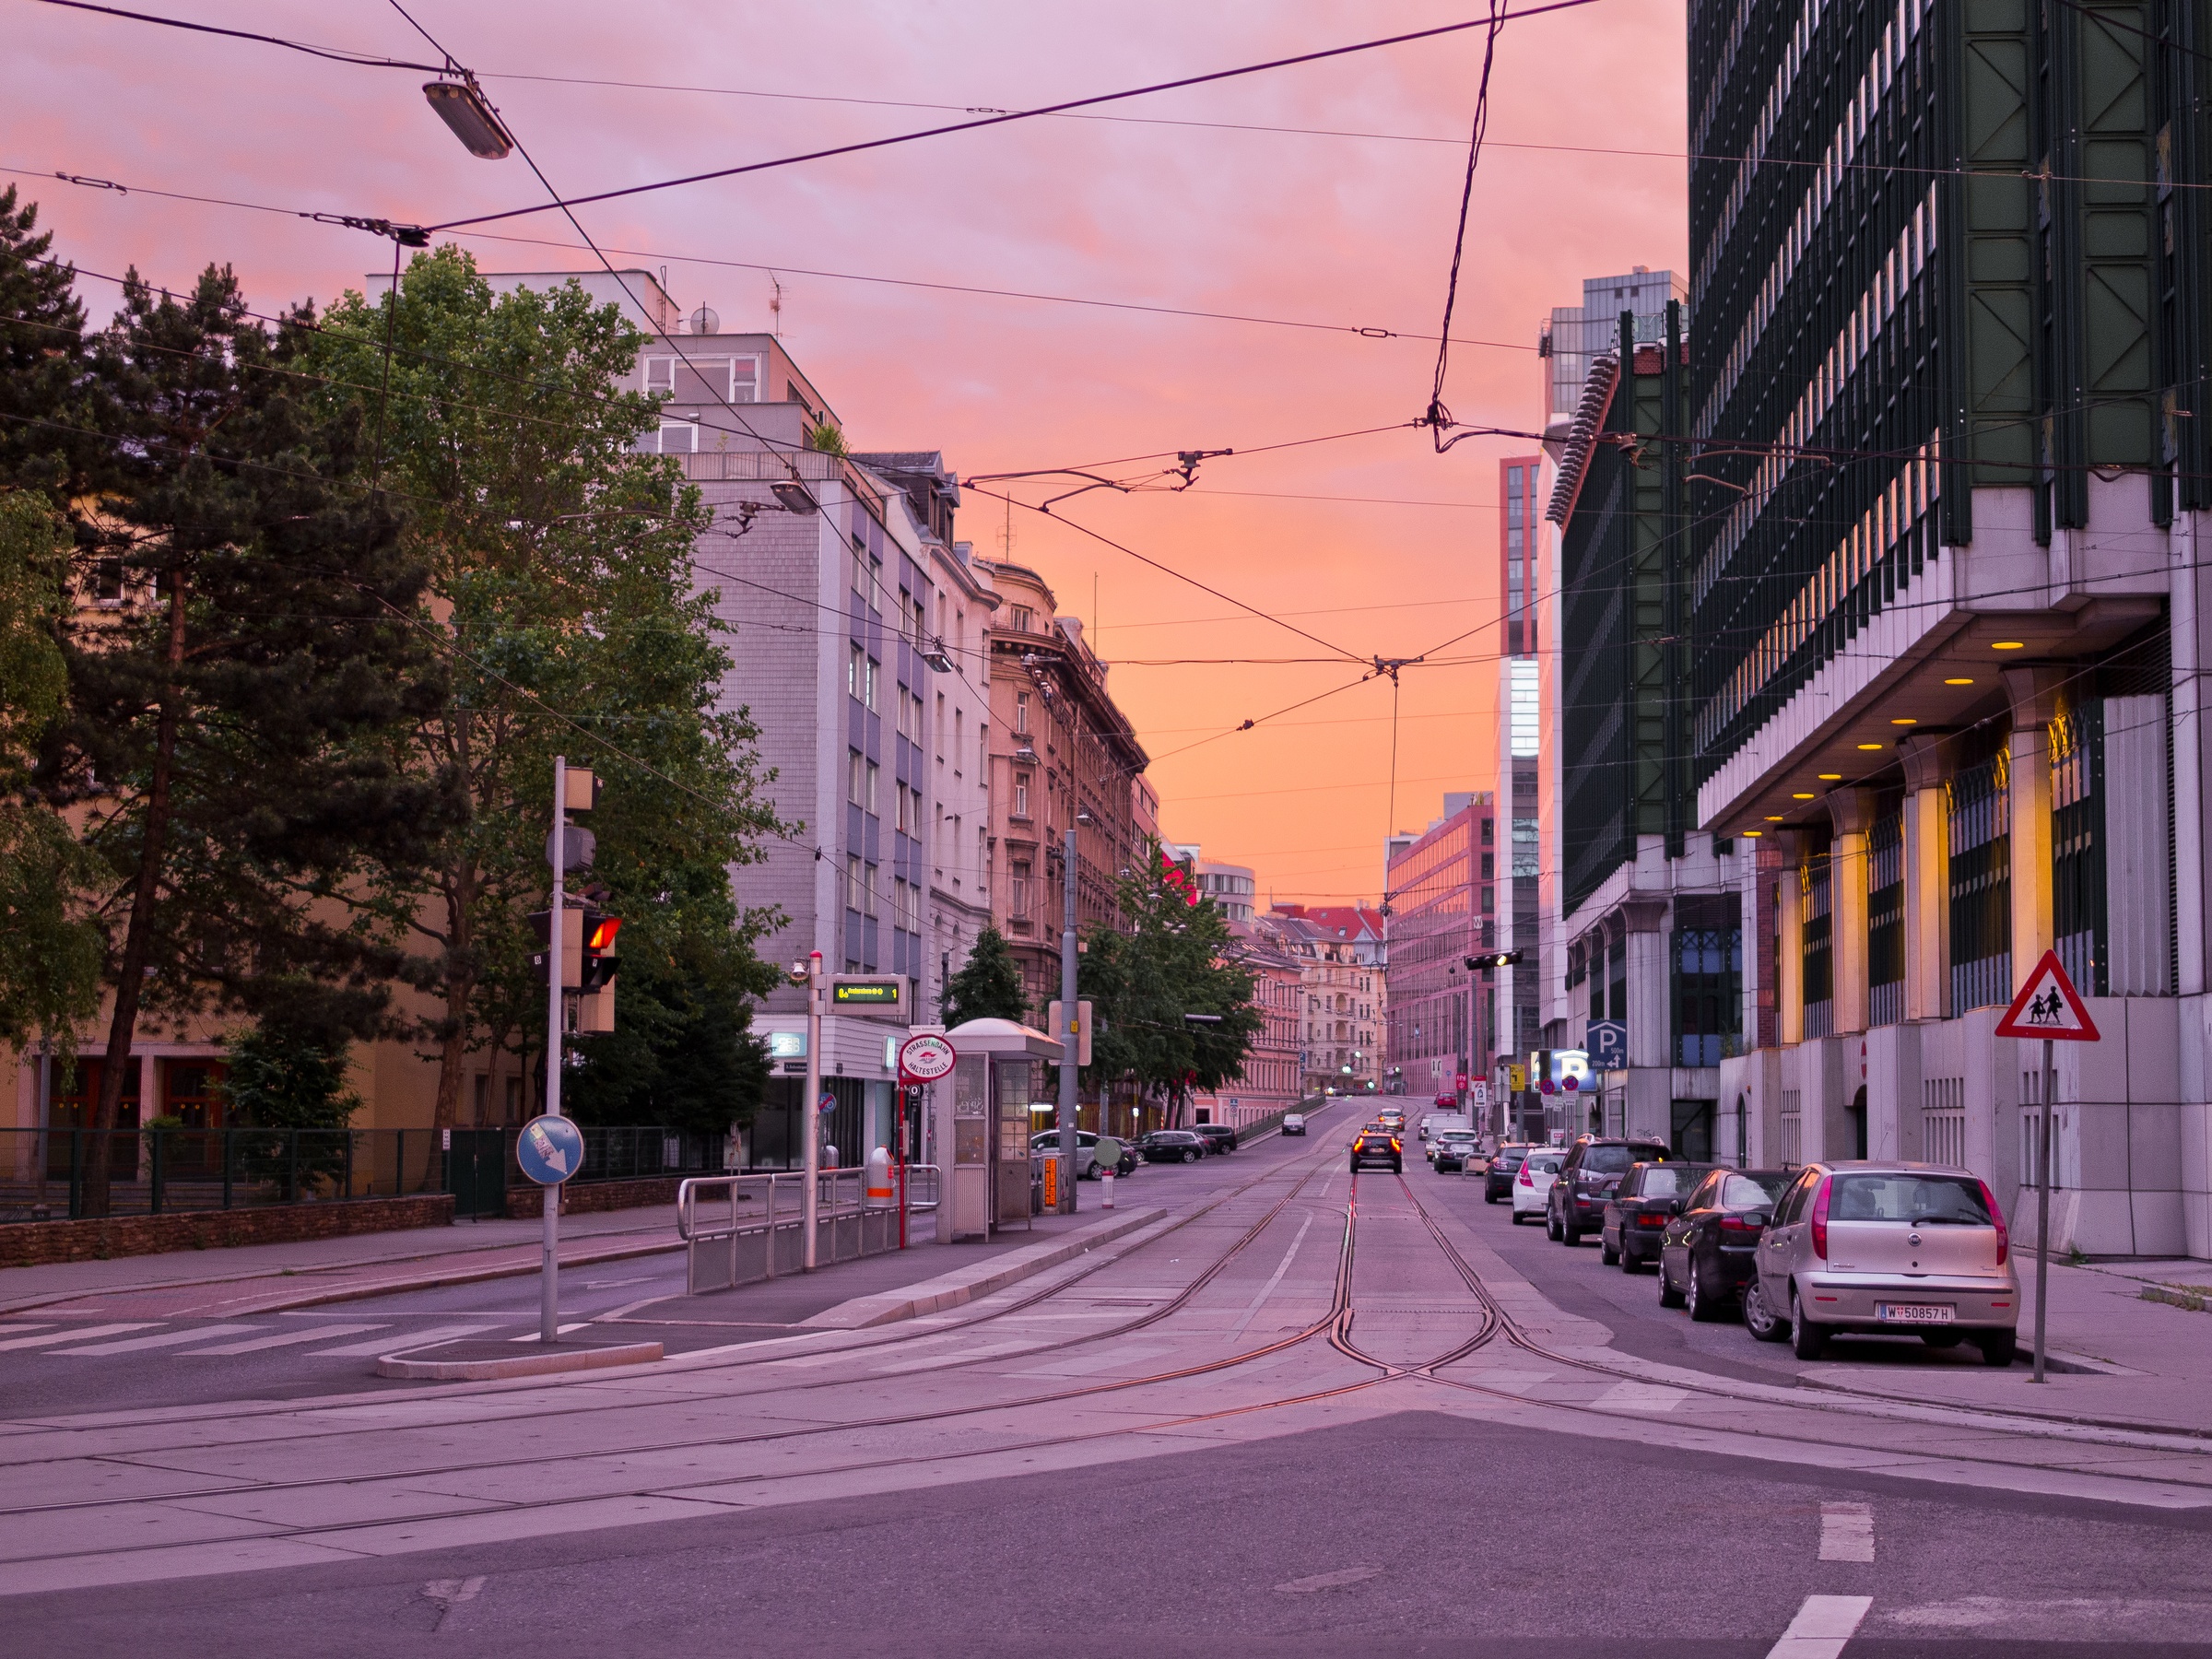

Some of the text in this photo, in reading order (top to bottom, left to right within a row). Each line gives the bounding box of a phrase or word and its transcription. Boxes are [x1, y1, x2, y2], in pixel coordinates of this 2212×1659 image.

[906, 1040, 950, 1055] STRASSENBAHN
[1600, 1030, 1618, 1053] P
[908, 1062, 948, 1075] HALTESTELLE
[1888, 1307, 1948, 1320] W 50857 H
